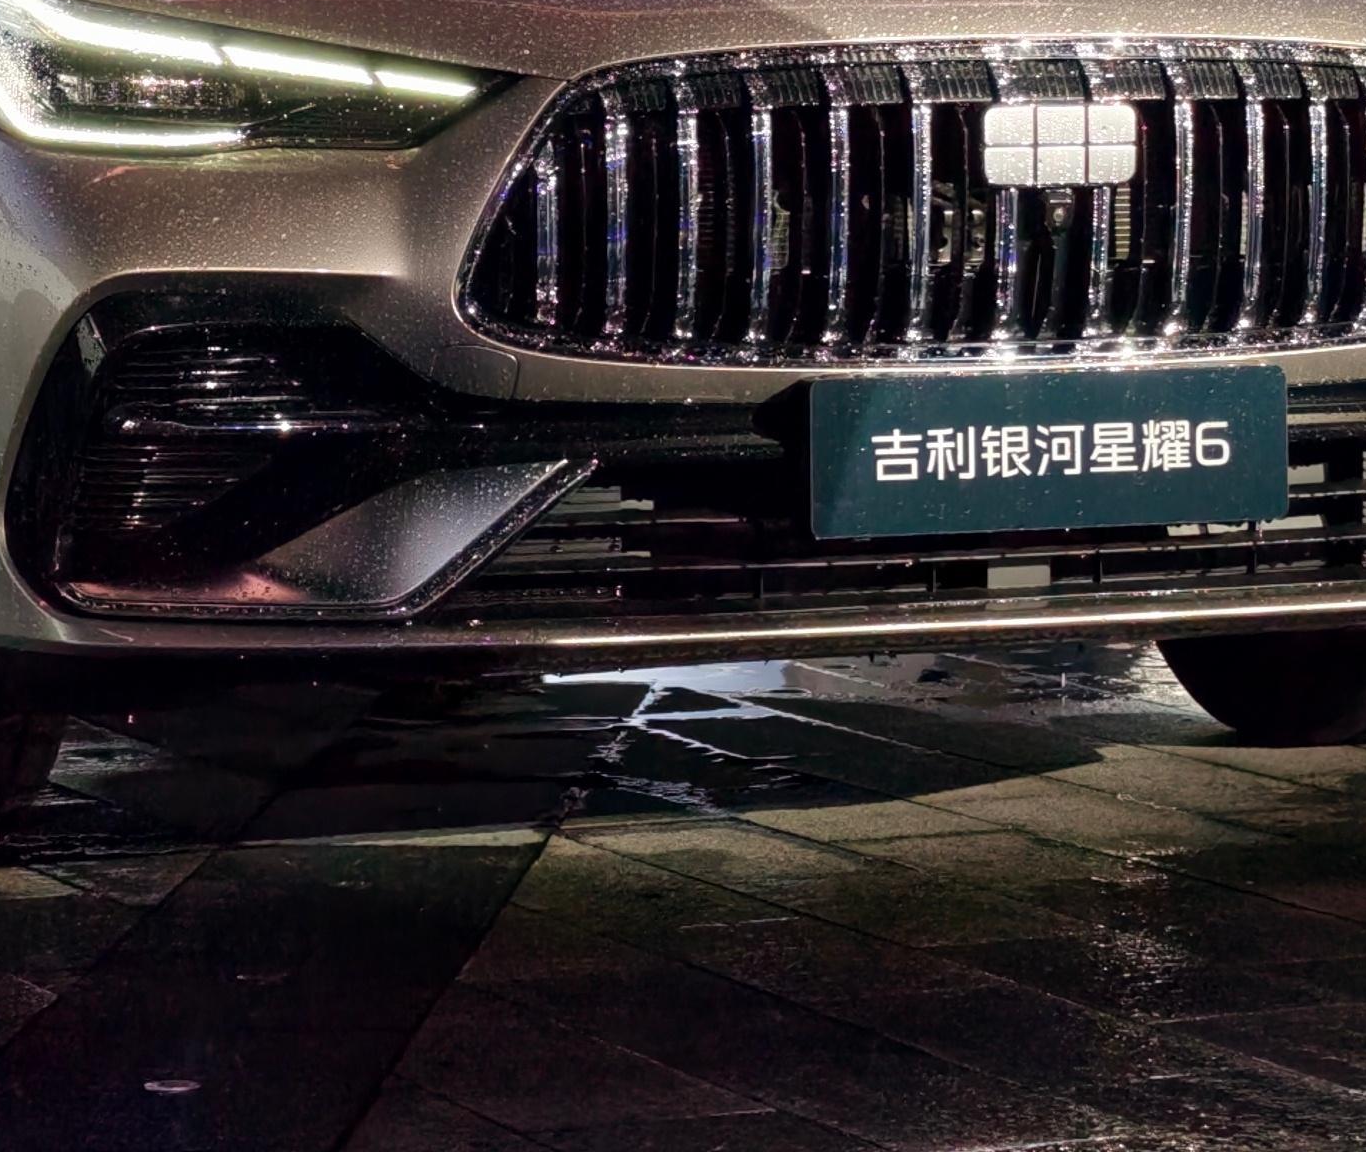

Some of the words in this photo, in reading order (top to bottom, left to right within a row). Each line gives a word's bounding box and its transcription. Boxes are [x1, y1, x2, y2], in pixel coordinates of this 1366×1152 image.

[871, 419, 1231, 482] 吉利银河星耀6
